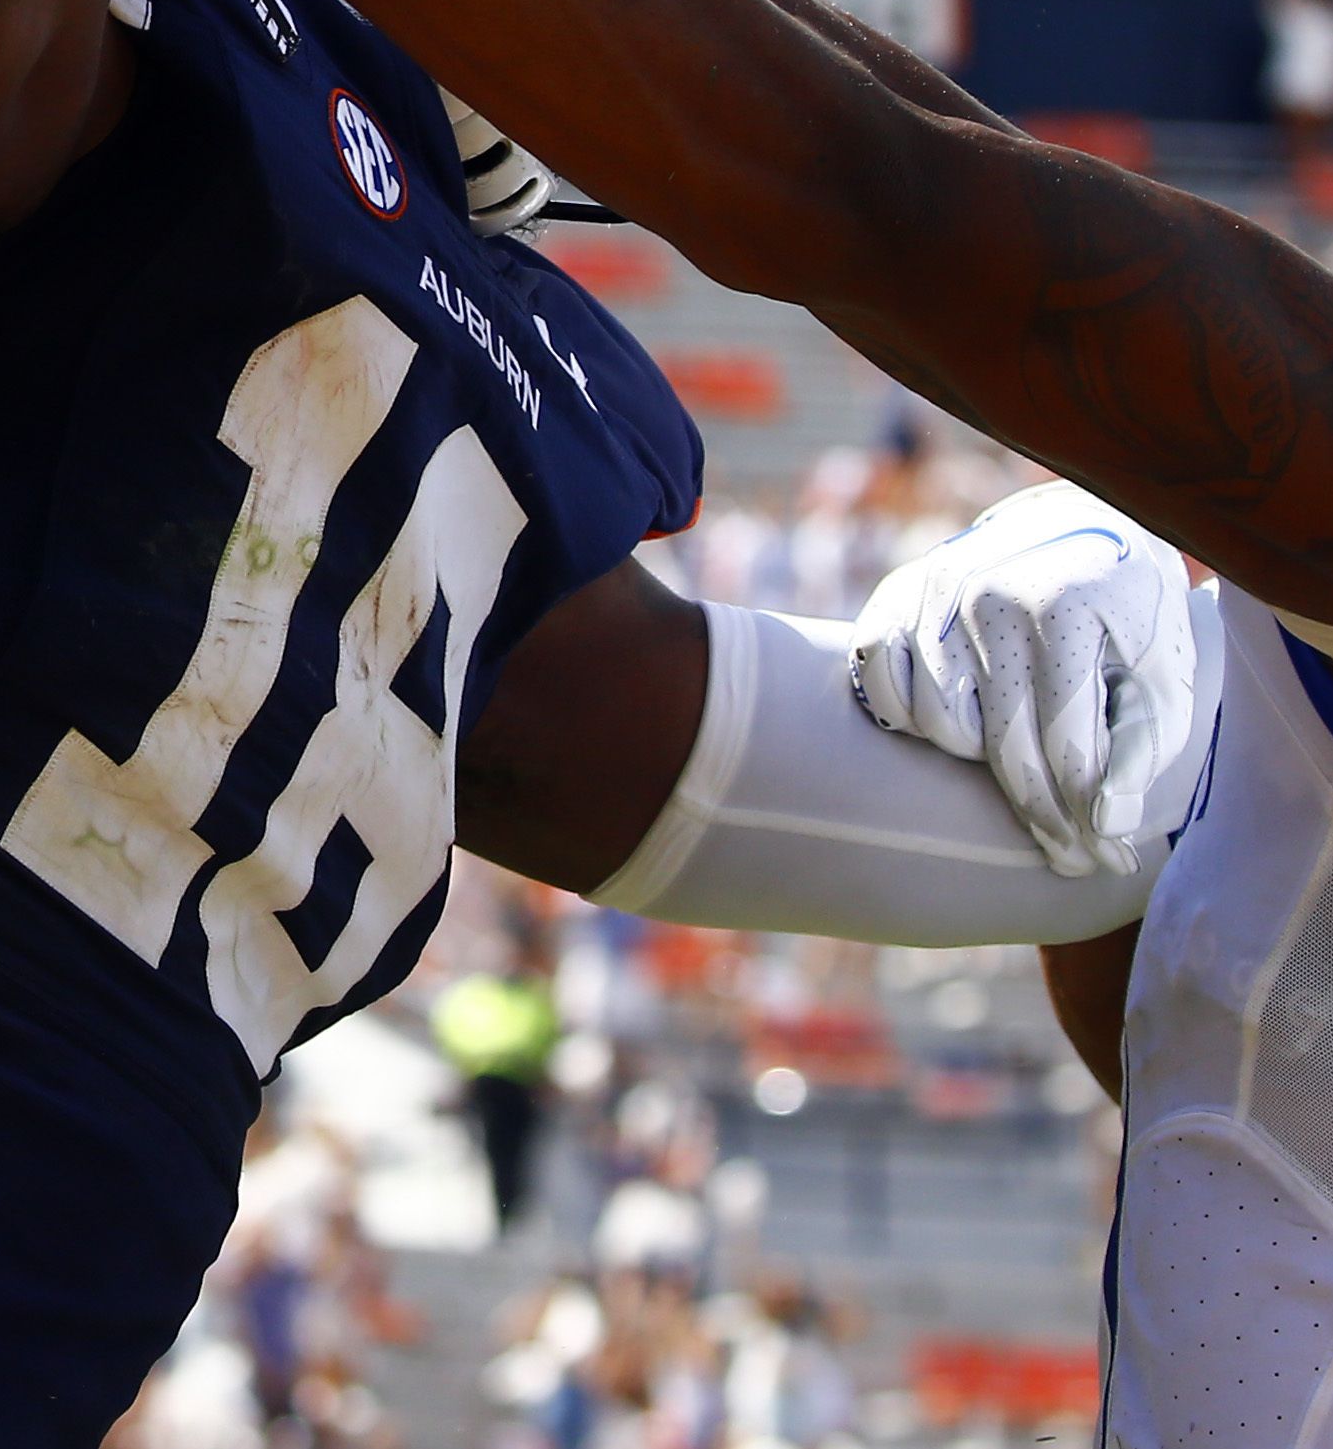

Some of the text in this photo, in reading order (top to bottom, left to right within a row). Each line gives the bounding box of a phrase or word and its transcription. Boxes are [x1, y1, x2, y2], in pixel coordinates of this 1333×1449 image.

[336, 97, 401, 211] SEC
[417, 254, 541, 430] AUBURN
[0, 293, 529, 1081] 18
